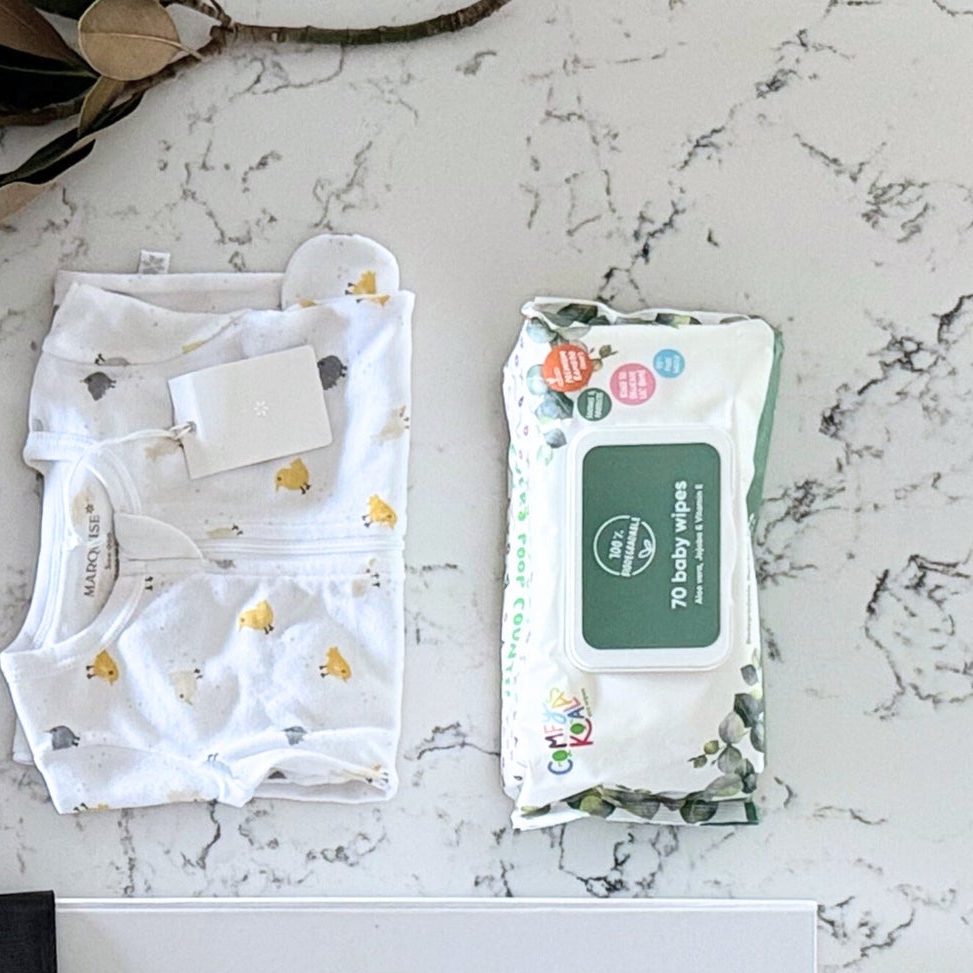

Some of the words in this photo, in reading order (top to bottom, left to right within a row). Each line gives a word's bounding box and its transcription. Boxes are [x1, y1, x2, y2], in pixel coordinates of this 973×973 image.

[671, 480, 691, 532] wipes
[609, 529, 625, 560] 100%
[671, 537, 691, 583] baby
[671, 587, 687, 610] 70
[542, 702, 573, 775] COMFY
